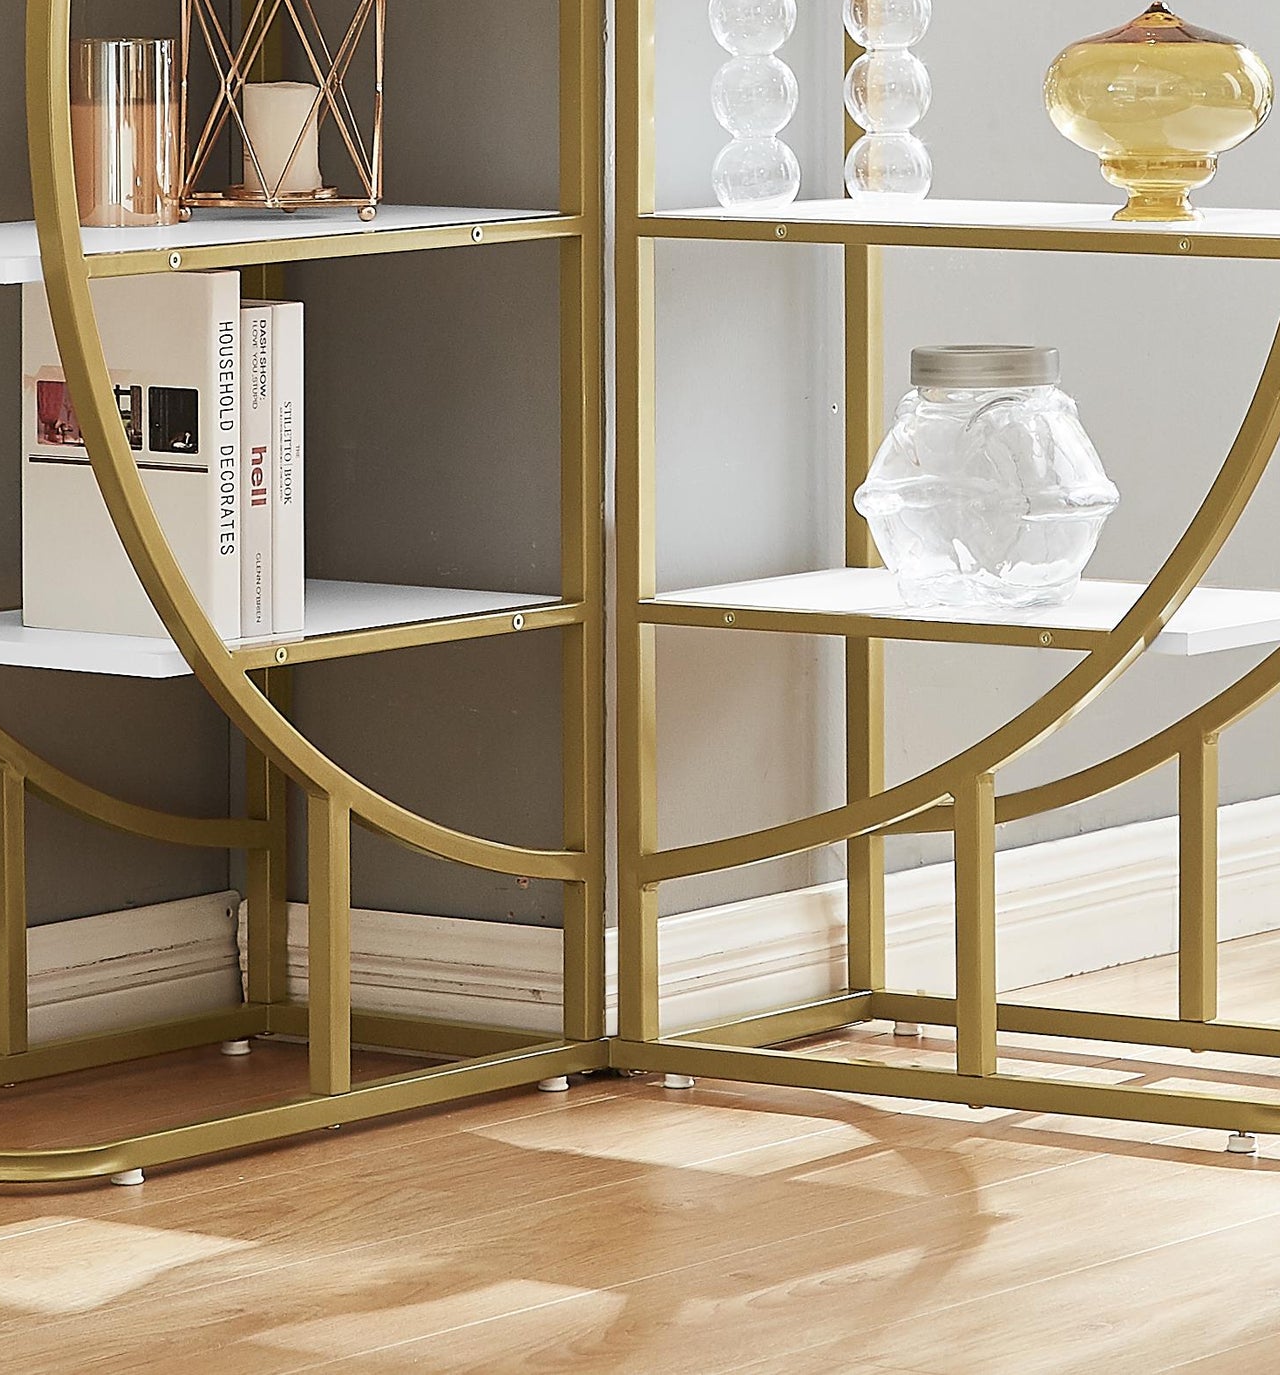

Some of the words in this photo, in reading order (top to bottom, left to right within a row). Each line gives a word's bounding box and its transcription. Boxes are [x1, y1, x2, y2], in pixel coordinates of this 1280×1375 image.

[259, 319, 267, 355] DASH
[218, 321, 234, 432] HOUSEHOLD
[283, 401, 293, 463] STILETTO
[219, 445, 235, 556] DECORATES
[250, 445, 268, 507] hell
[284, 468, 293, 505] BOOK
